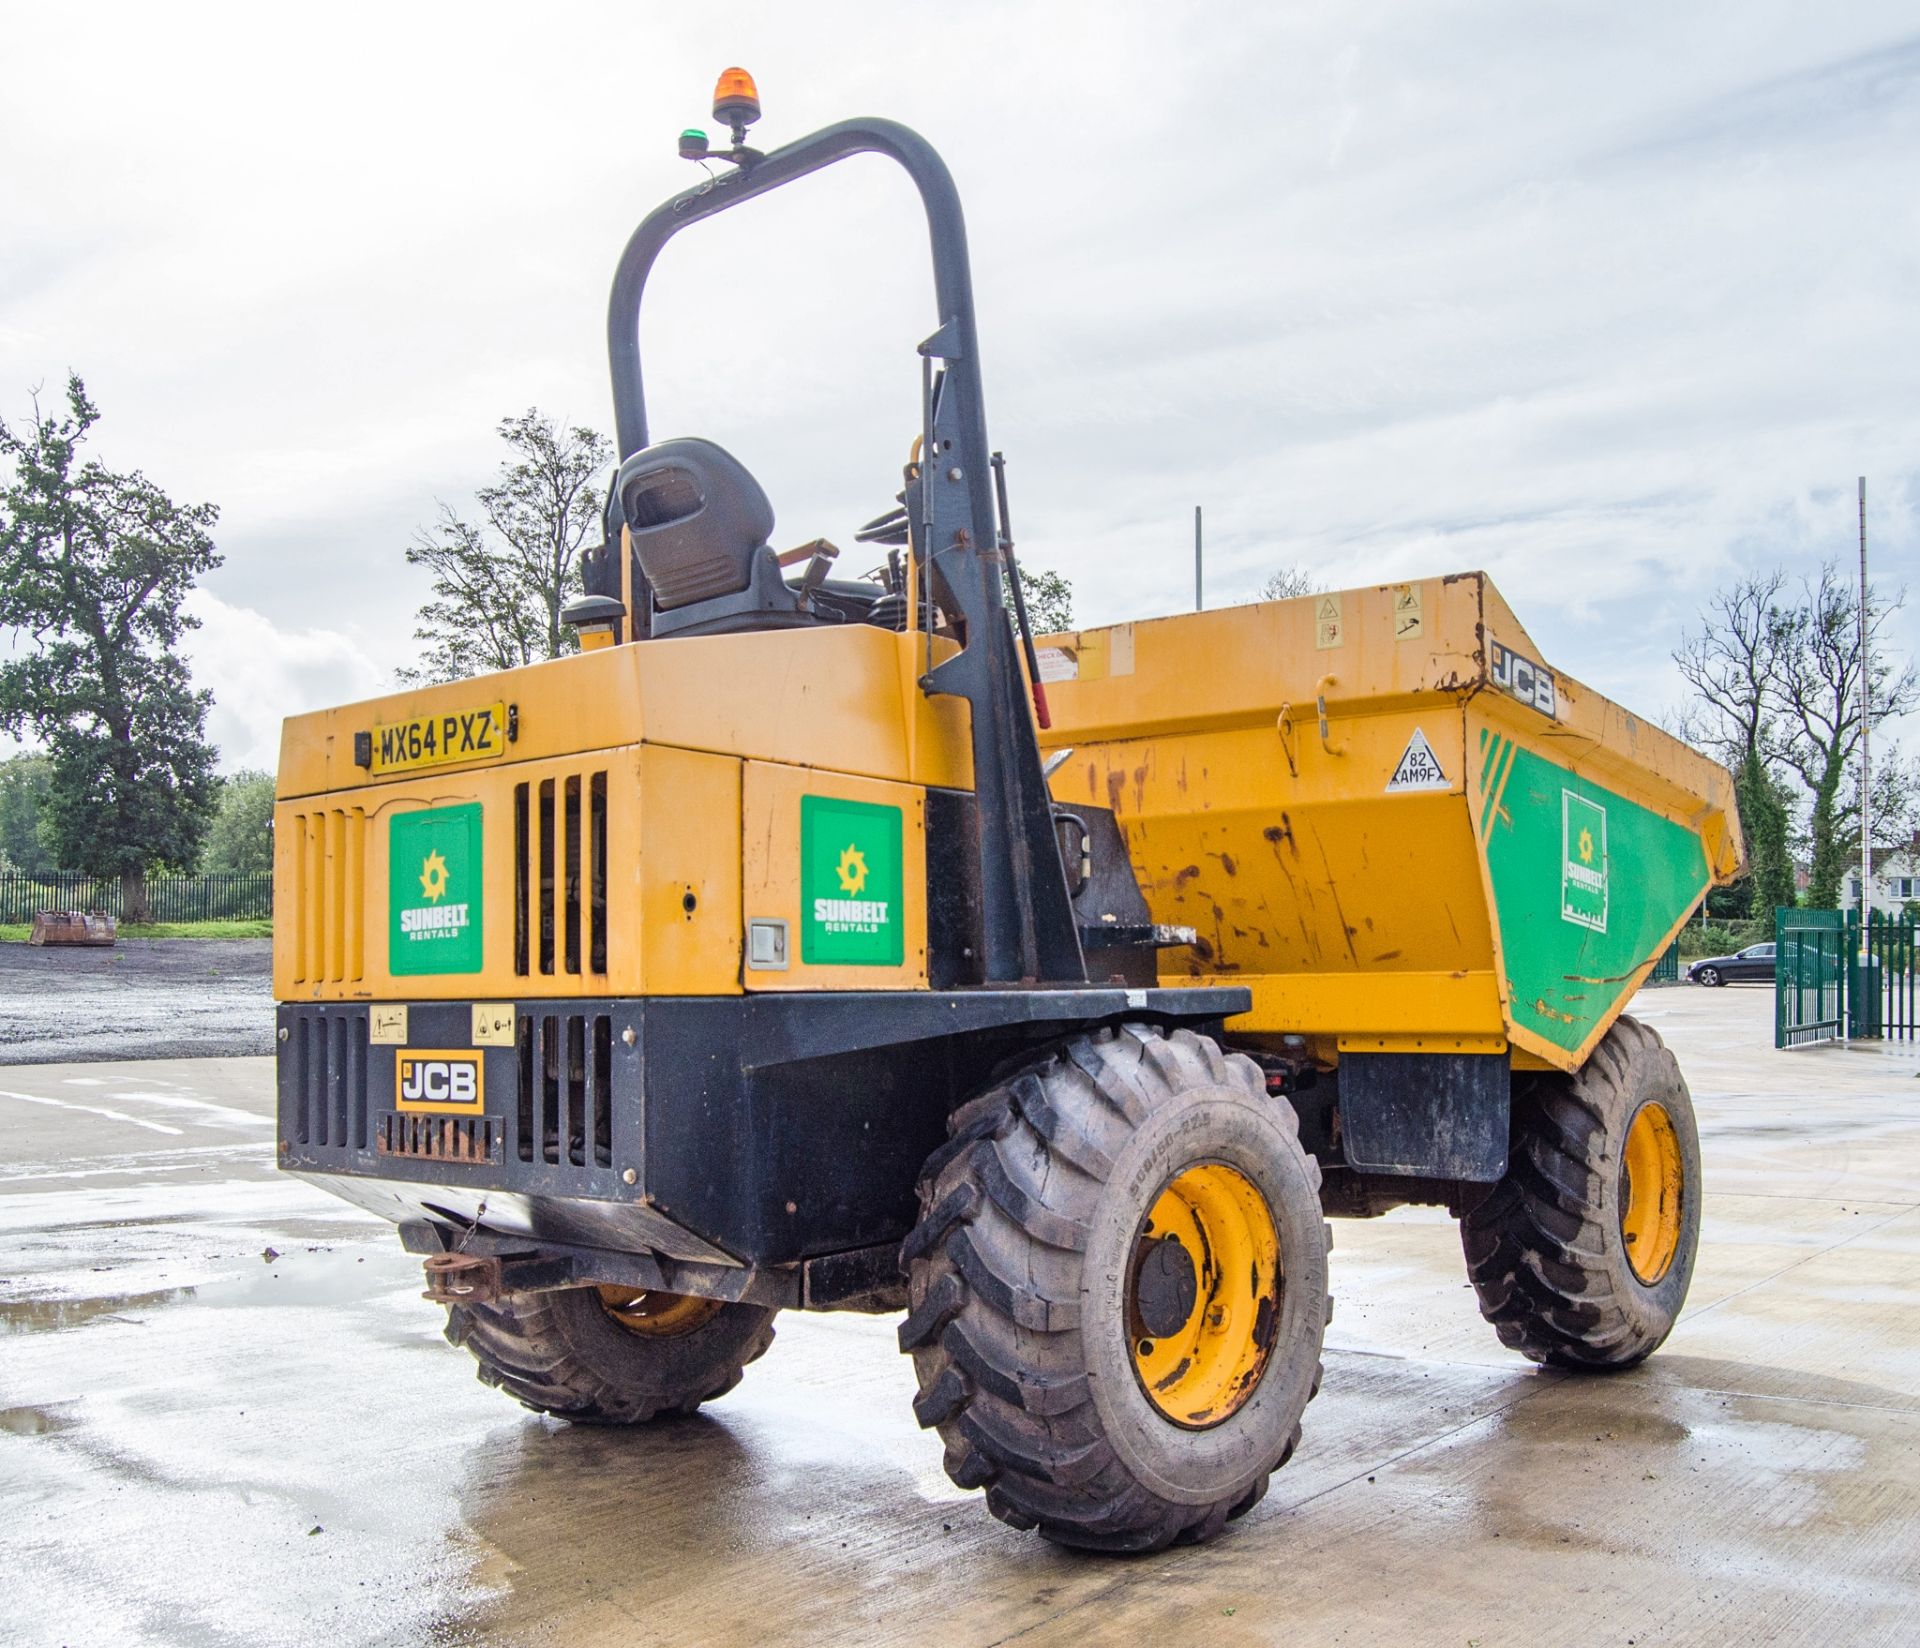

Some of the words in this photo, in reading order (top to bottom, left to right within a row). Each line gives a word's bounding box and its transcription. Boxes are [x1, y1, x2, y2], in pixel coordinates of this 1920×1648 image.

[1493, 651, 1555, 715] JCB
[381, 719, 437, 765] MX64
[443, 711, 491, 755] PXZ
[1410, 752, 1426, 767] 82
[1400, 767, 1436, 783] AM9F
[1567, 861, 1603, 889] SUNBELT
[400, 903, 469, 932] SUNBELT
[814, 898, 888, 924] SUNBELT
[409, 927, 458, 941] RENTALS
[825, 921, 878, 933] RENTALS
[402, 1062, 477, 1101] JCB
